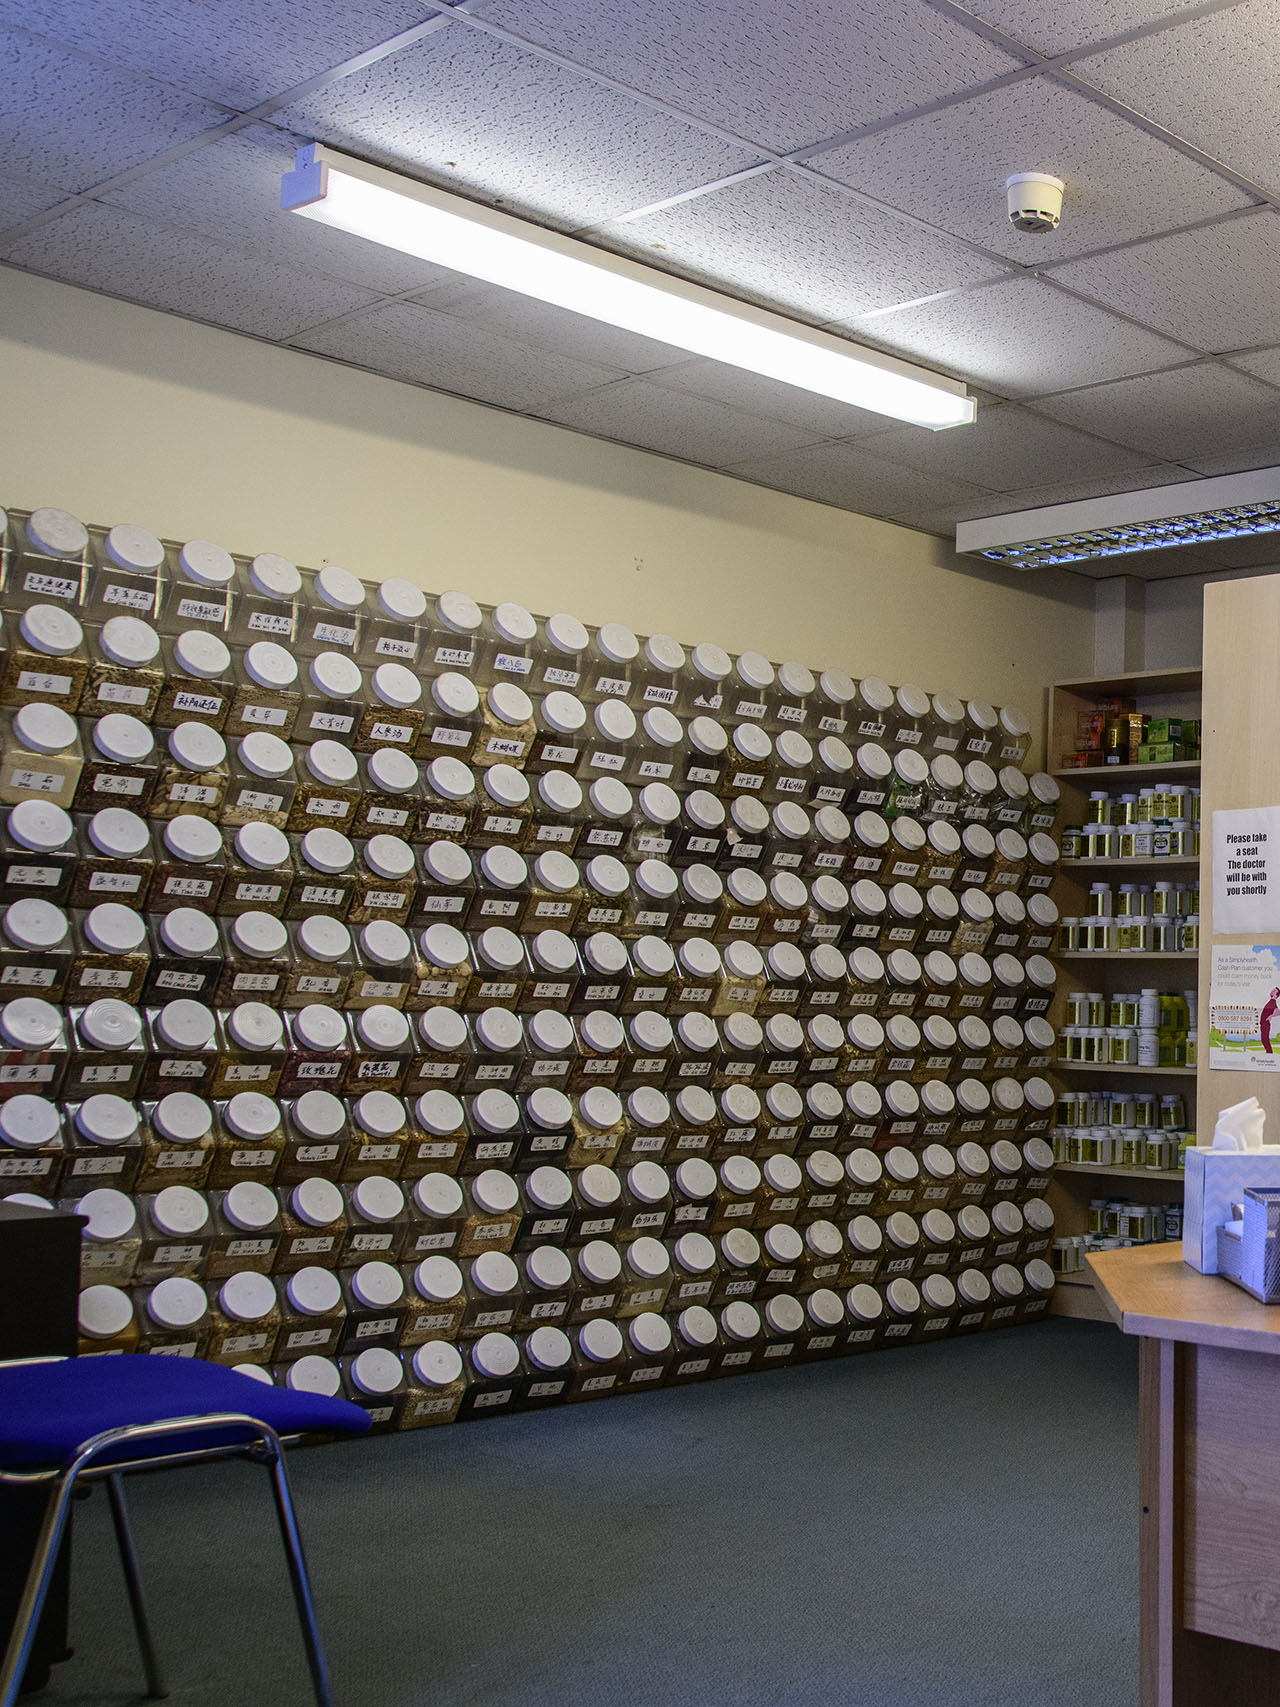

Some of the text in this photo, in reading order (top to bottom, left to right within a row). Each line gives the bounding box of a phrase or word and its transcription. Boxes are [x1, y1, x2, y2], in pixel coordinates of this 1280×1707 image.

[1227, 833, 1267, 844] Please take
[1236, 847, 1258, 856] a seat
[1228, 860, 1265, 869] The doctor
[1227, 872, 1267, 882] will be with
[1227, 885, 1267, 896] you shortly
[301, 1066, 337, 1075] 玫瑰花
